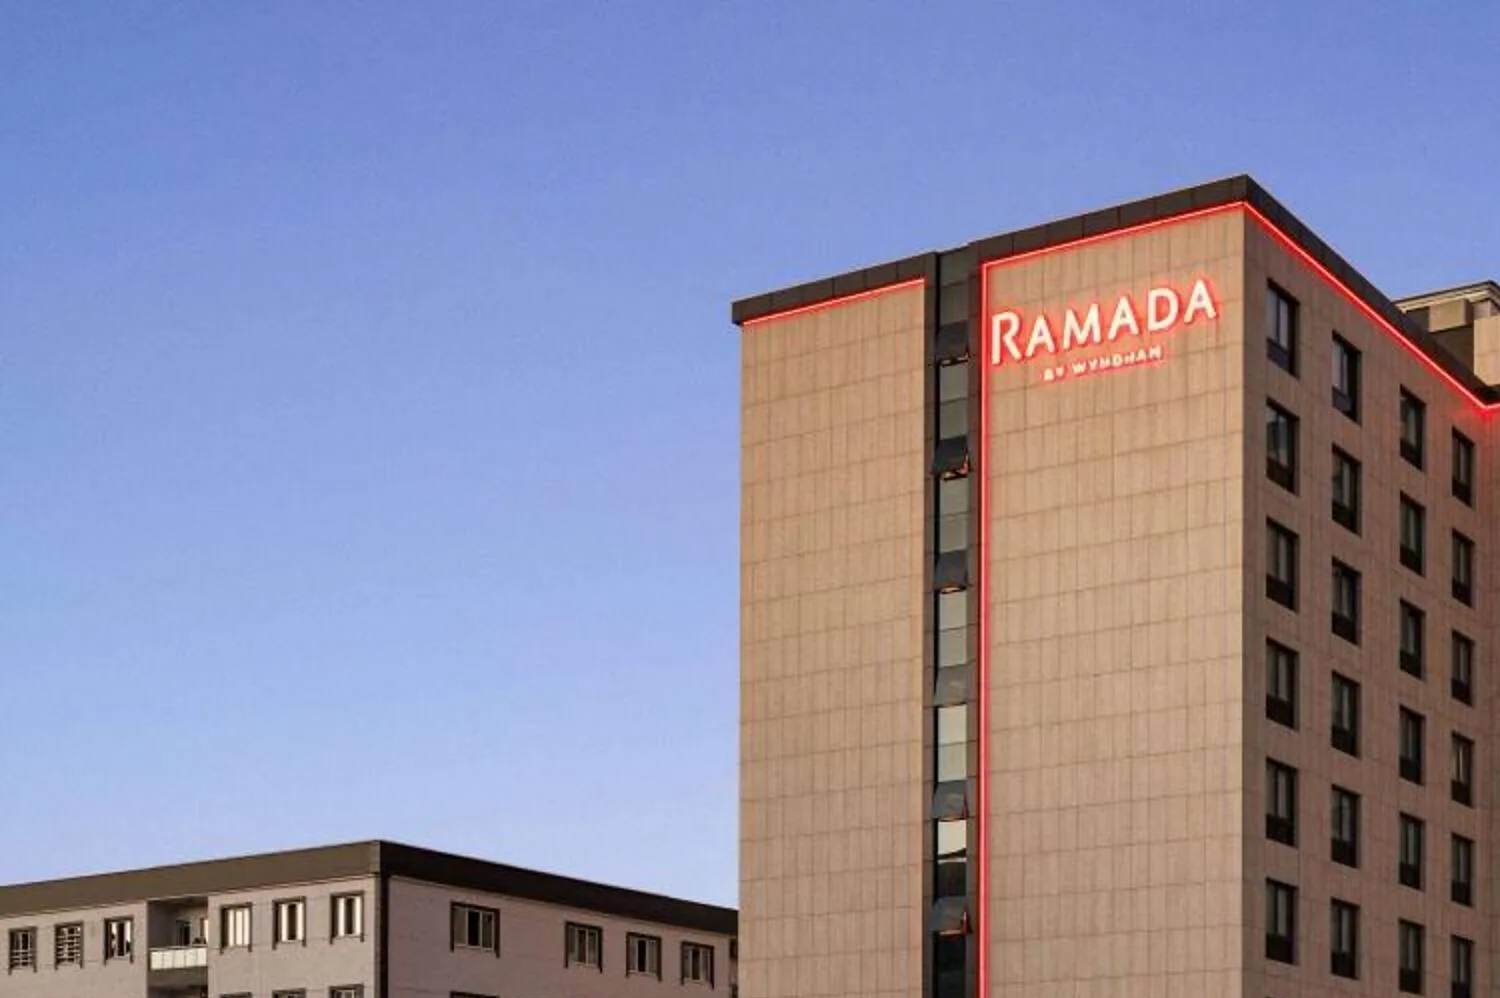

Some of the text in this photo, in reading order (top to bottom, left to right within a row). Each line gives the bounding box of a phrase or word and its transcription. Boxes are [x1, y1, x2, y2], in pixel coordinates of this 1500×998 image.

[991, 279, 1217, 365] RAMADA
[1044, 346, 1162, 381] BY WYNDHAM
